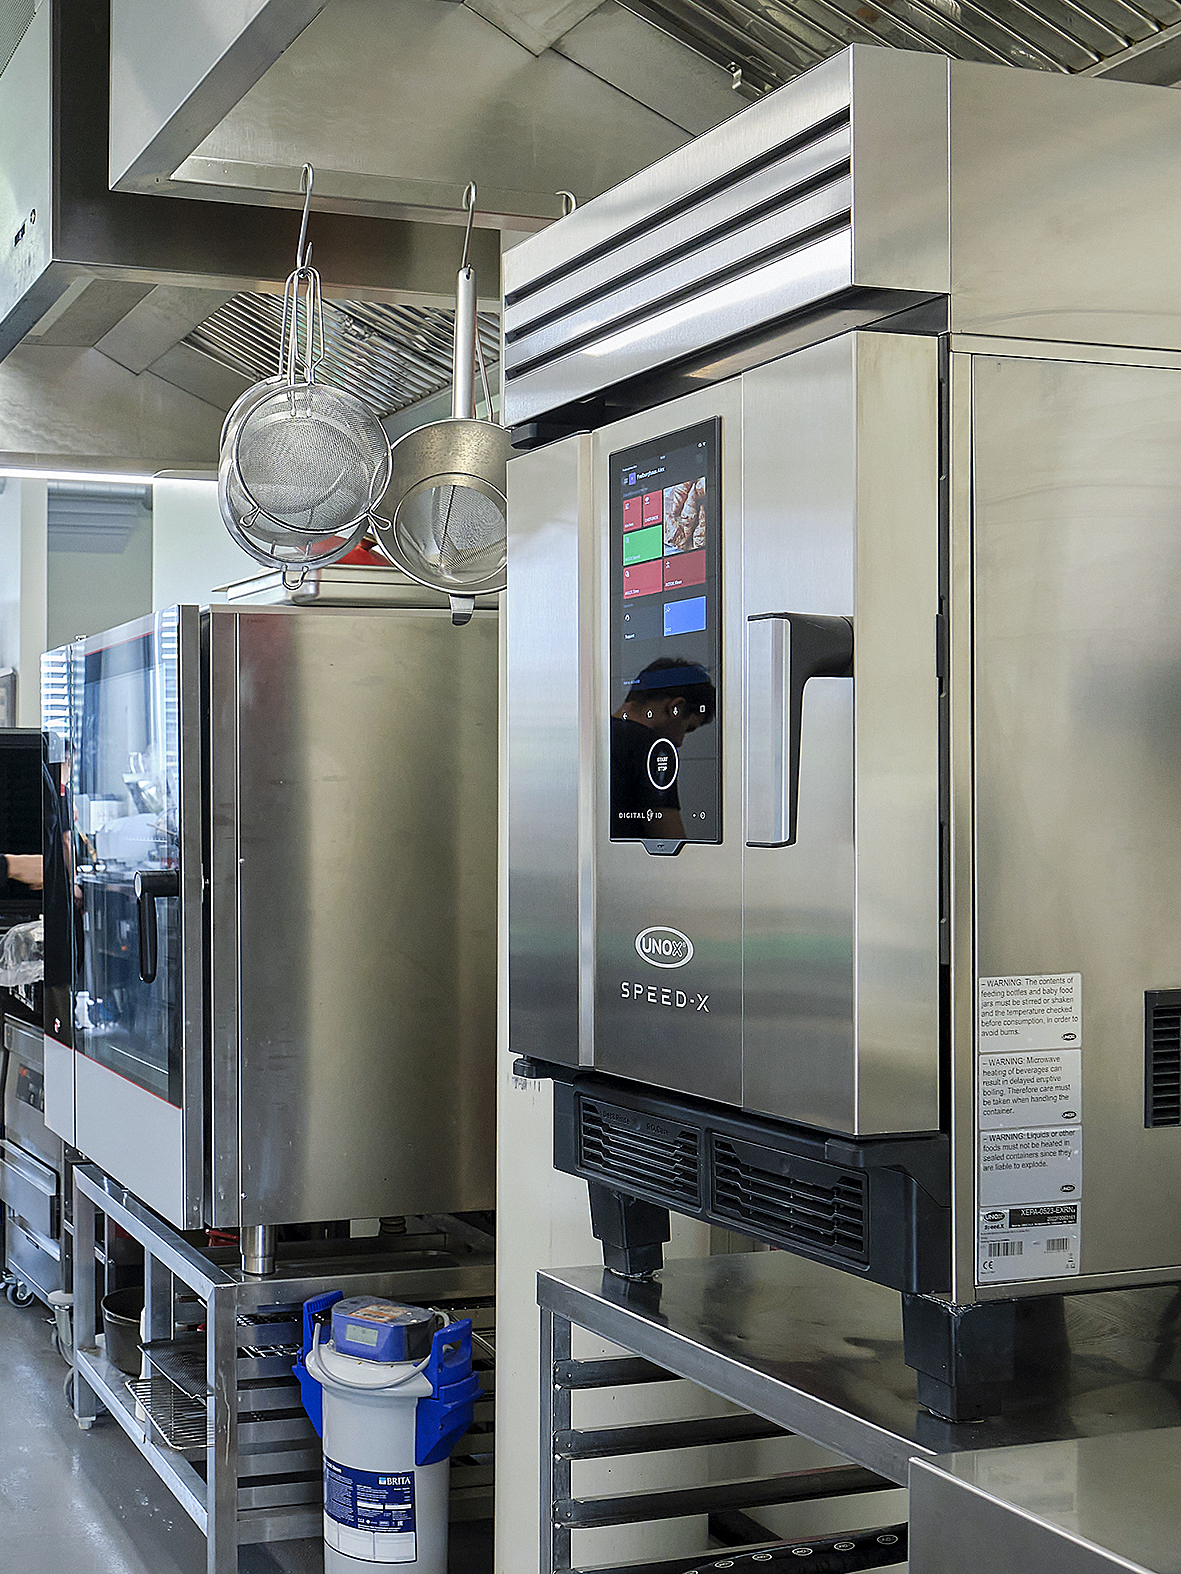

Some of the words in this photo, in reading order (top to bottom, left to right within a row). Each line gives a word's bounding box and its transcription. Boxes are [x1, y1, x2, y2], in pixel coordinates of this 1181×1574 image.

[642, 937, 683, 957] UNOX
[621, 982, 710, 1013] SPEED-X
[981, 1001, 993, 1009] jars
[1007, 1008, 1045, 1016] temperature
[988, 1057, 1025, 1066] WARNING:
[983, 1069, 1006, 1077] heating
[1010, 1077, 1034, 1085] delayed
[1036, 1075, 1061, 1083] eruptive
[1031, 1095, 1057, 1103] handling
[983, 1108, 1014, 1116] container.
[989, 1132, 1026, 1141] WARNING:
[983, 1144, 1000, 1152] foods
[1006, 1152, 1039, 1160] containers
[1058, 1149, 1072, 1157] they
[1022, 1161, 1048, 1169] explode.
[387, 1477, 411, 1485] BRITA
